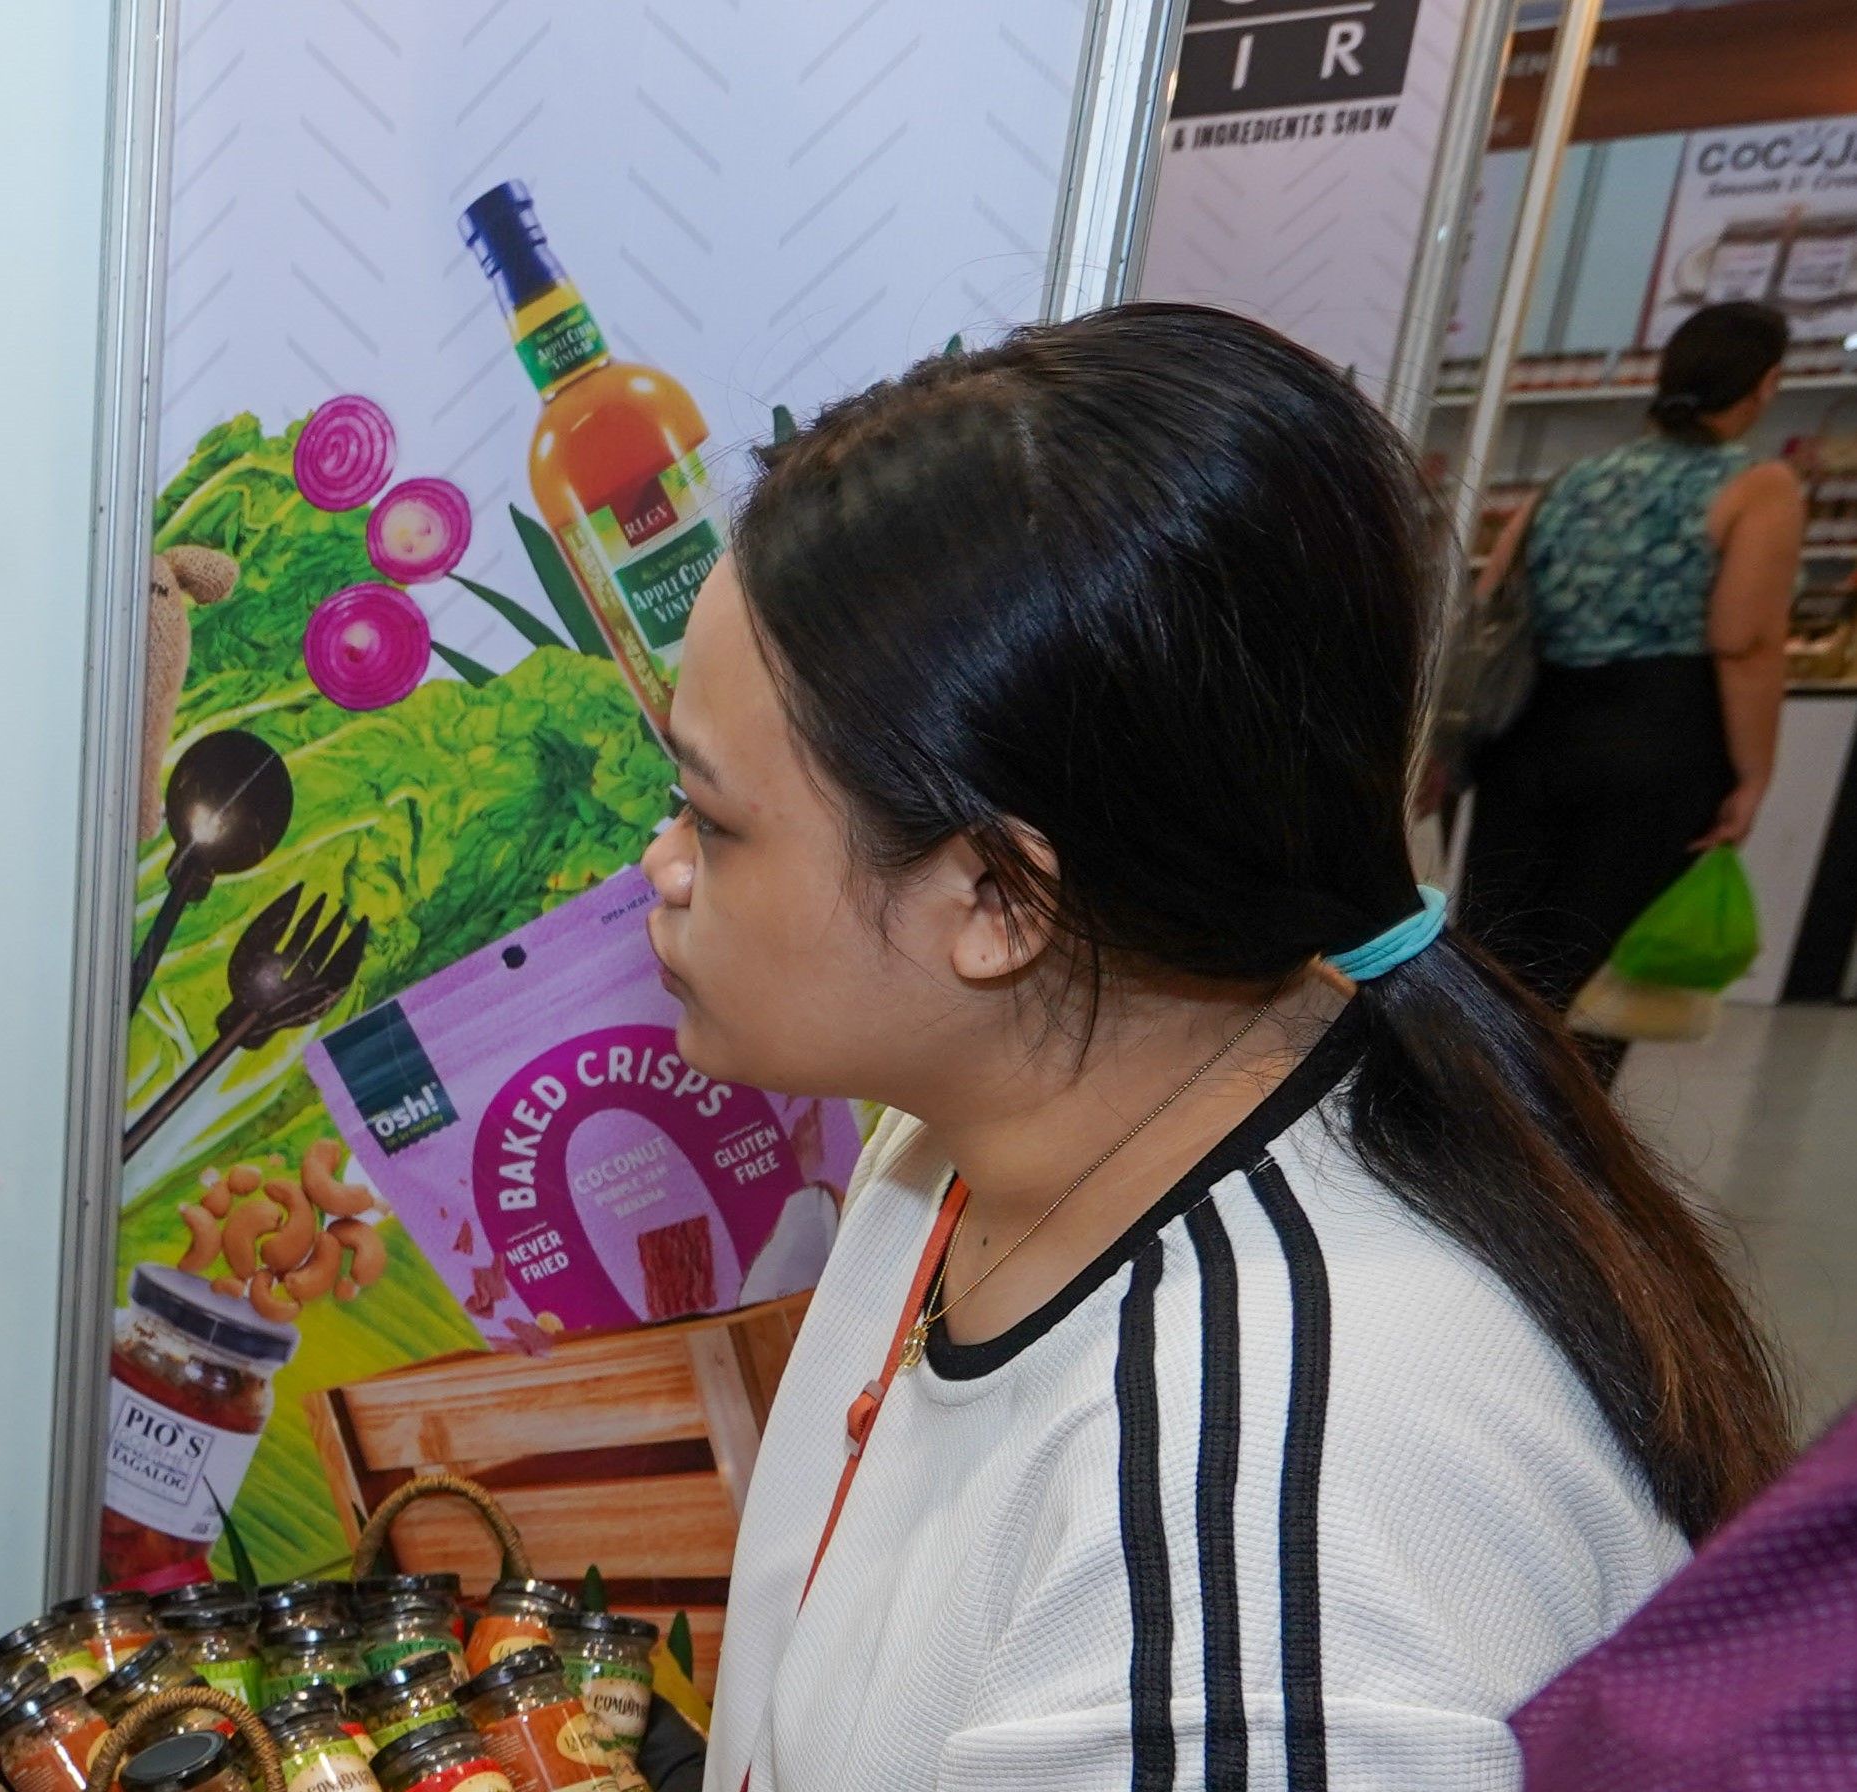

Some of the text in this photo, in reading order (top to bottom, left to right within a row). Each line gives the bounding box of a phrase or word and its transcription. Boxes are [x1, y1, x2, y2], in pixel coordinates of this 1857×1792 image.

[1192, 112, 1326, 150] INGREDIENTS
[1332, 104, 1400, 136] SHOW
[631, 576, 681, 612] APPLE
[498, 1075, 568, 1211] BAKED
[576, 1046, 733, 1118] CRISPS
[714, 1125, 780, 1169] GLUTEN
[573, 1136, 671, 1194] COCONUT
[734, 1150, 781, 1185] FREE
[505, 1229, 563, 1267] NEVER
[520, 1251, 570, 1285] FRIED
[109, 1450, 187, 1492] TAGALOG
